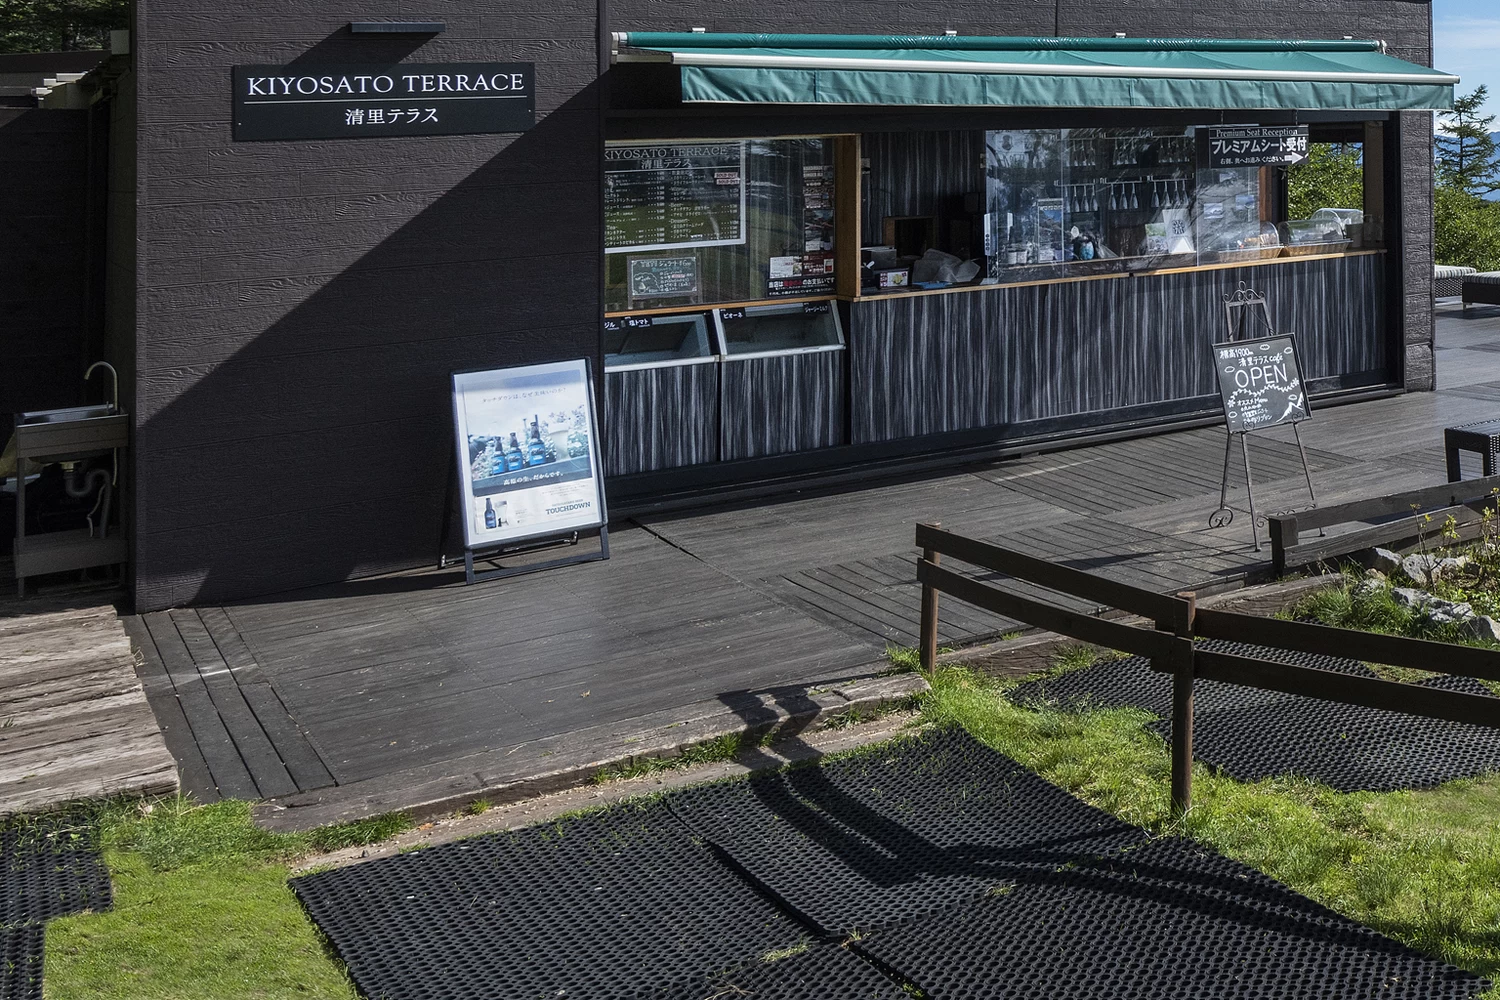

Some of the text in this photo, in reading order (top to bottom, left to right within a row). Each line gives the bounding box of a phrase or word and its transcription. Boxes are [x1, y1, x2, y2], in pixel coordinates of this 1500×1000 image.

[248, 73, 525, 96] KIYOSATO TERRACE
[345, 107, 439, 126] 清里テラス
[1216, 127, 1298, 138] Premium Seat Reception
[670, 146, 728, 157] TERRACE
[1211, 136, 1307, 154] プレミアムシート受付
[641, 159, 692, 169] 清里テラス
[1235, 363, 1288, 388] OPEN
[545, 501, 591, 515] TOUCHDOWN
